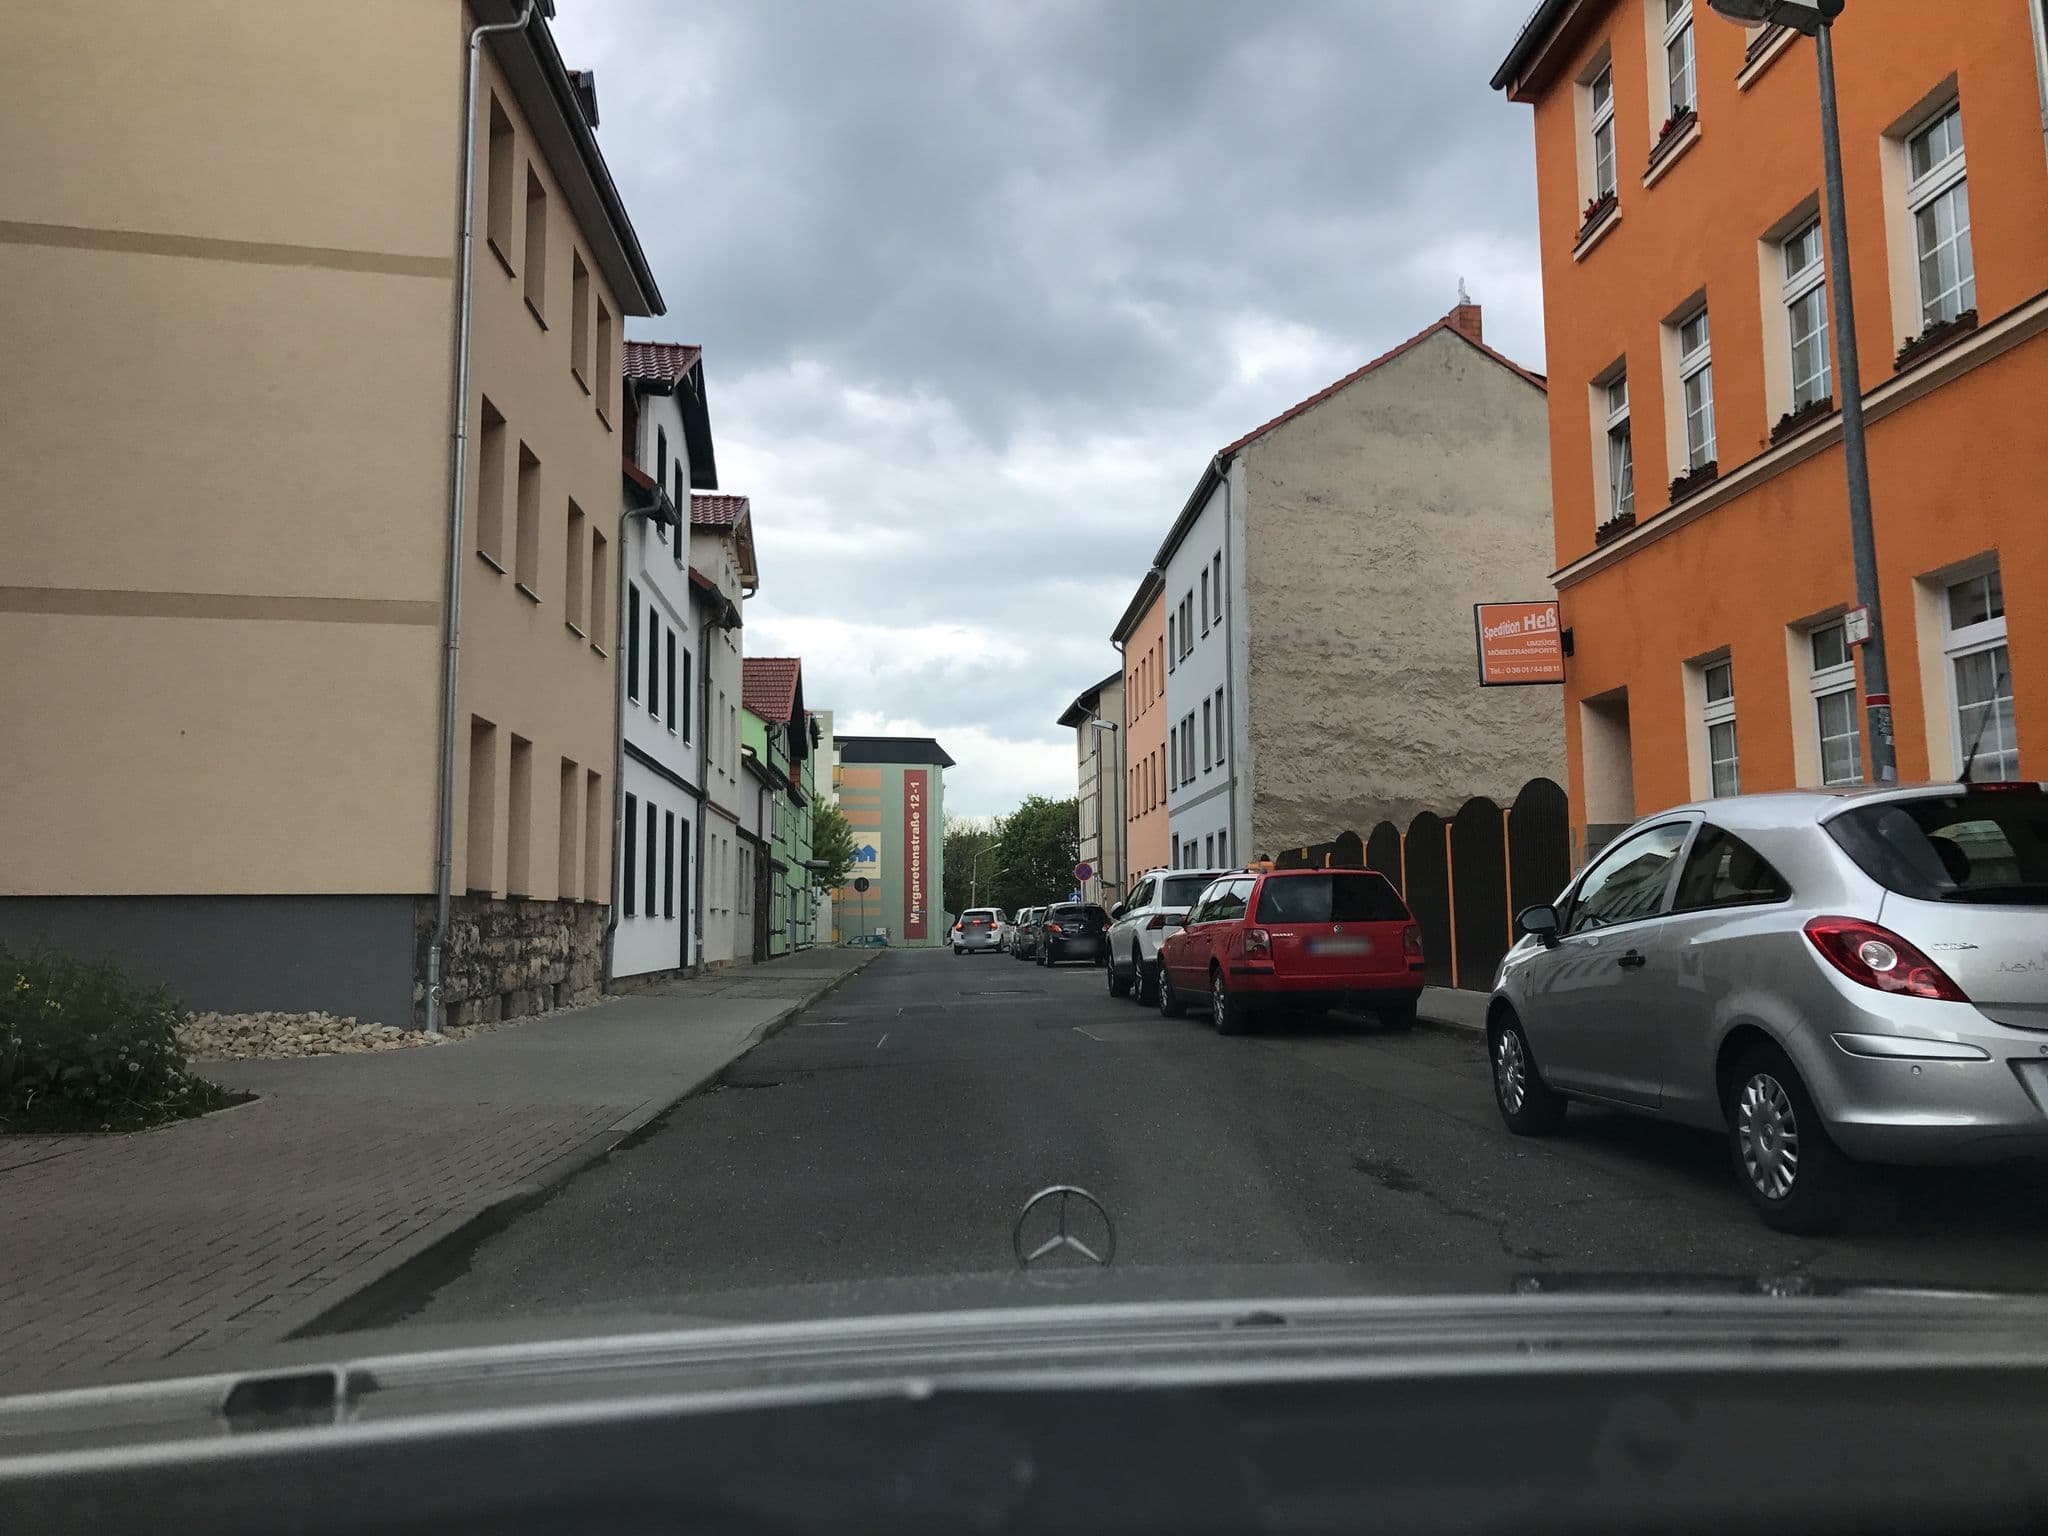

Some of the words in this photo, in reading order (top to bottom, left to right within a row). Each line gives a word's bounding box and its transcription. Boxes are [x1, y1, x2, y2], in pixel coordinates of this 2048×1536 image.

[1484, 620, 1520, 641] Spedition
[1523, 608, 1556, 630] Heß
[910, 782, 920, 809] 12-1
[910, 812, 921, 924] Margaretenstraße
